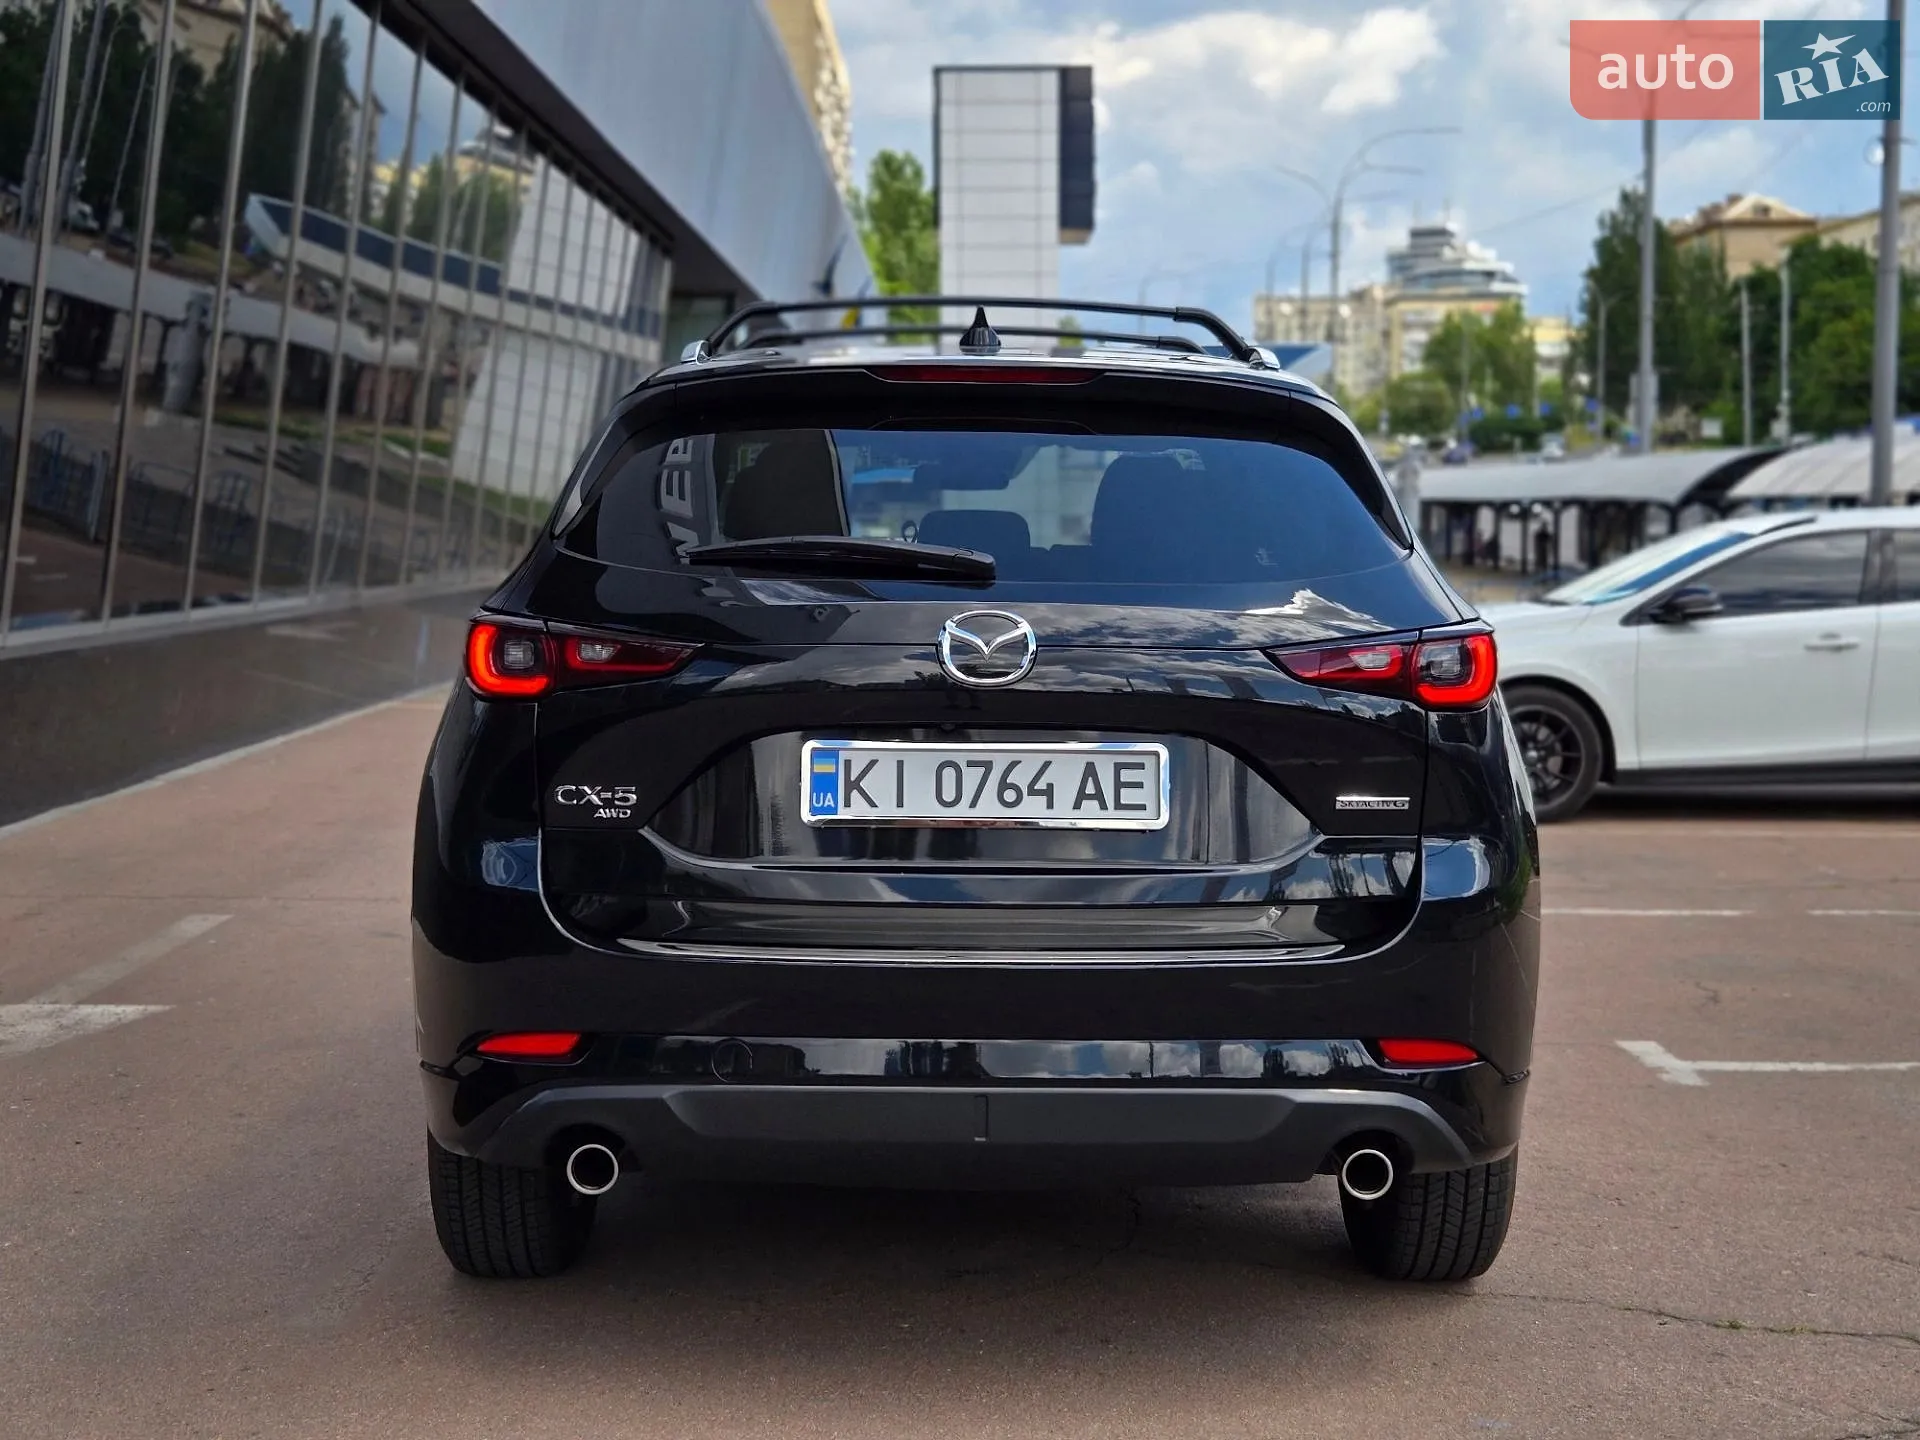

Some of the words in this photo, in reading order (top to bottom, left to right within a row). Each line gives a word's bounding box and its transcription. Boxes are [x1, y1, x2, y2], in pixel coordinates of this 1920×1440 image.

[843, 758, 905, 809] KI
[935, 758, 1054, 811] 0764
[1072, 760, 1147, 812] AE
[554, 784, 637, 807] CX-5
[812, 792, 836, 808] UA
[593, 808, 631, 819] AWD
